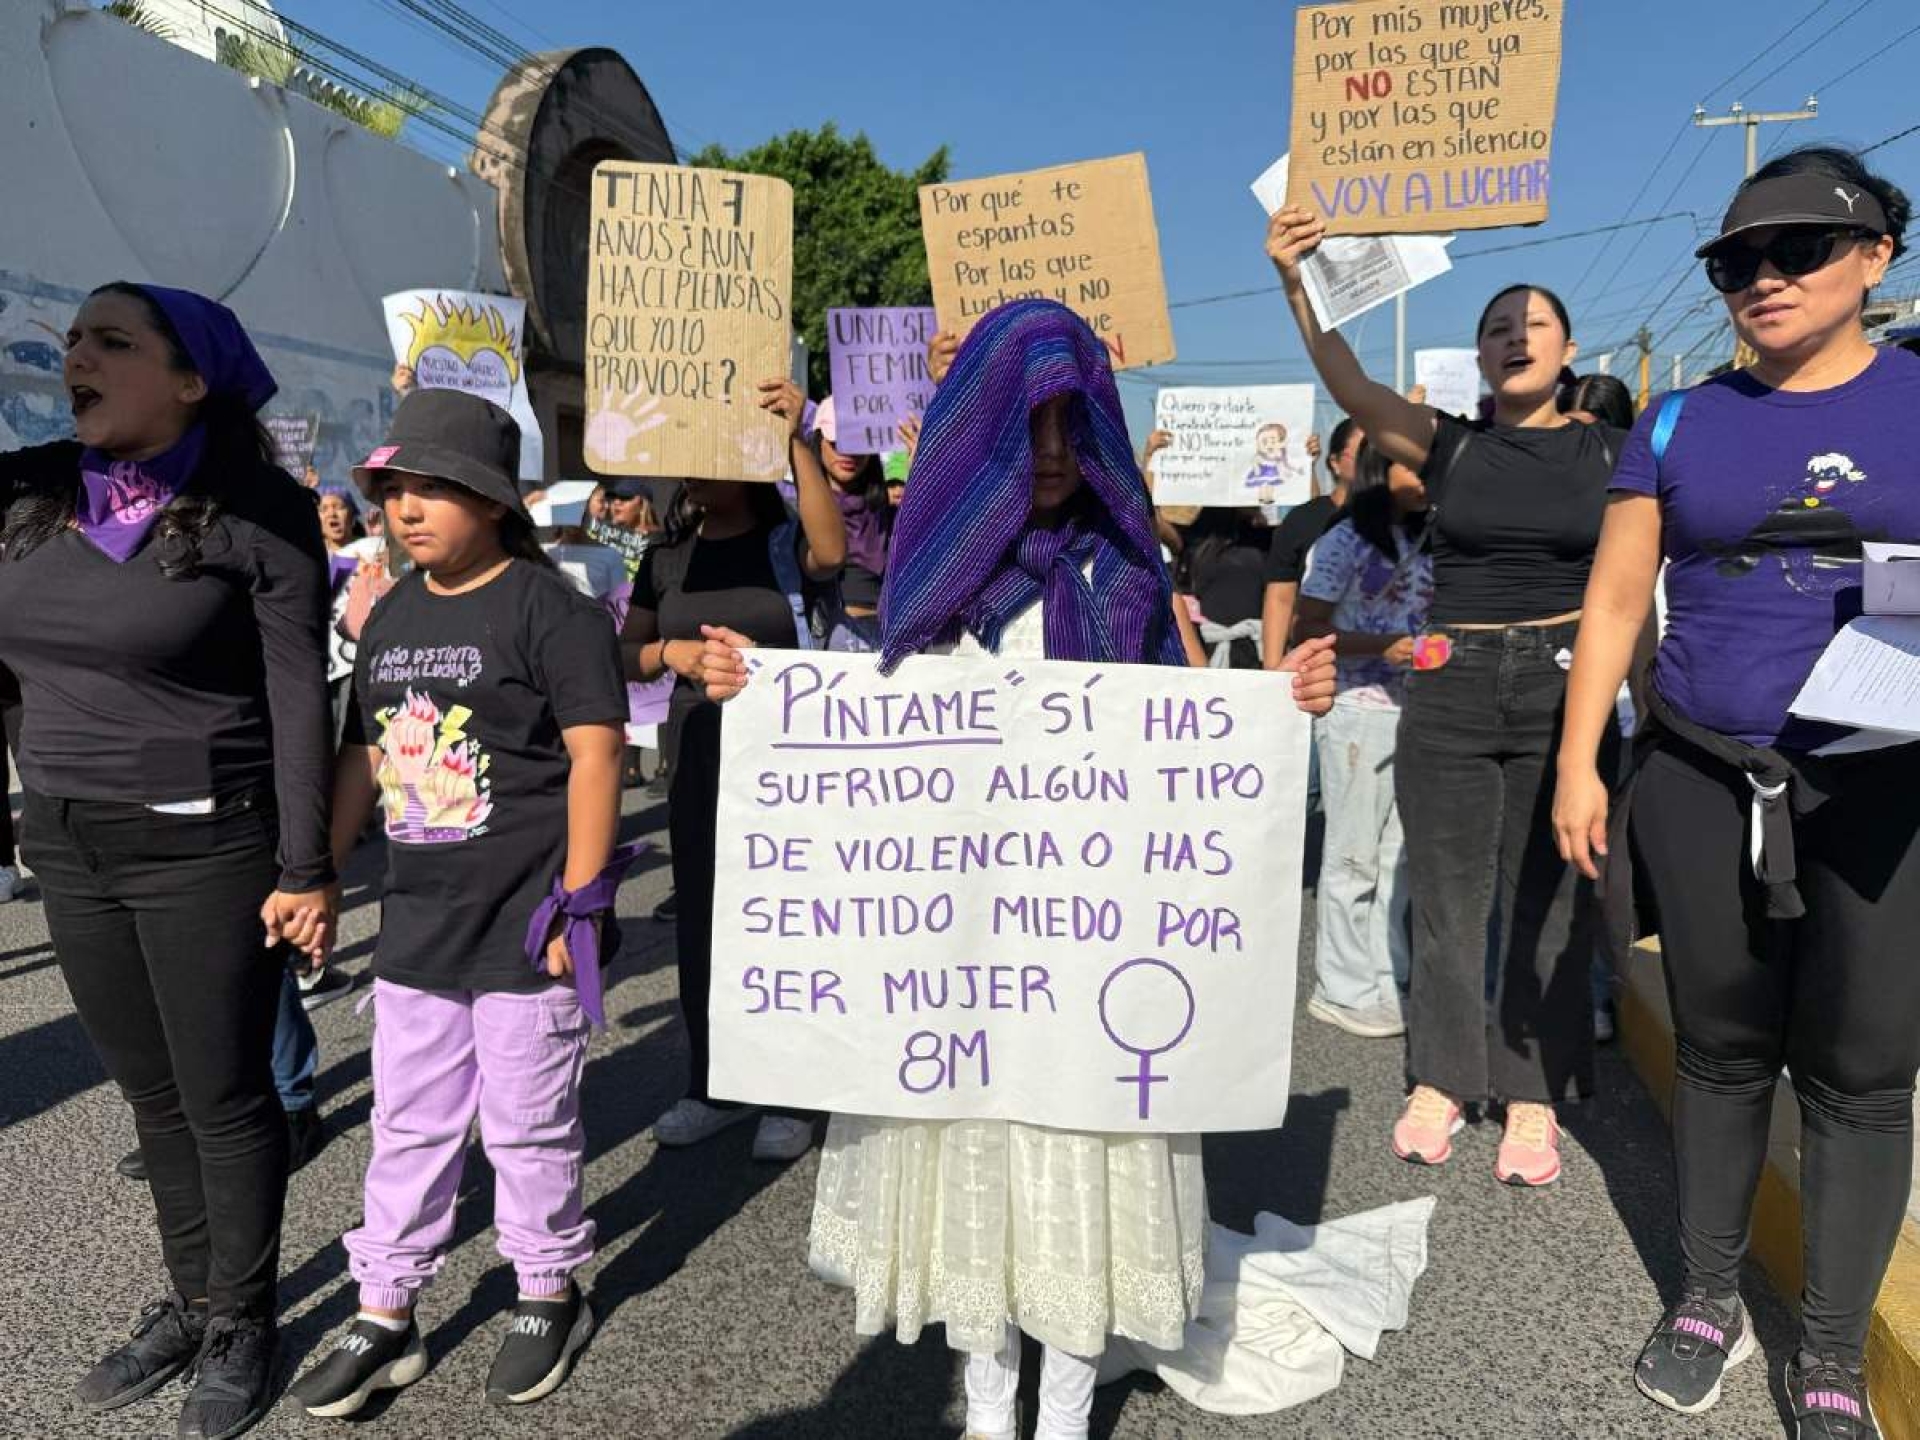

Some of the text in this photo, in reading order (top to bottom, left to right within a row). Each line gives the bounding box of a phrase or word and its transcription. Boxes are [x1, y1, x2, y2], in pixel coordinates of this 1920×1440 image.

[1311, 10, 1354, 40] Por
[1372, 5, 1422, 36] mis
[1315, 33, 1521, 82] por las que ya
[1345, 69, 1393, 102] NO
[1310, 97, 1500, 143] y por las que
[1322, 121, 1547, 166] están en silencio
[722, 178, 745, 228] 7
[932, 179, 1082, 222] Por qué te
[1310, 158, 1550, 220] VOY A LUCHAR
[957, 212, 1076, 250] espantas
[954, 253, 1093, 286] Por las que
[1079, 278, 1110, 304] NO
[675, 268, 783, 322] PIENSAS
[853, 394, 894, 415] POR
[1179, 433, 1201, 452] NO
[1041, 673, 1103, 734] SÍ
[1144, 697, 1233, 741] HAS
[756, 752, 1264, 807] SUFRIDO ALGÚN TIPO
[744, 830, 1233, 876] DE VIOLENCIA O HAS
[741, 893, 1241, 951] SENTIDO MIEDO POR
[742, 965, 1057, 1013] SER MUJER
[899, 1029, 990, 1093] 8M
[1672, 1316, 1724, 1347] PUMA
[1805, 1391, 1861, 1418] PUMA
